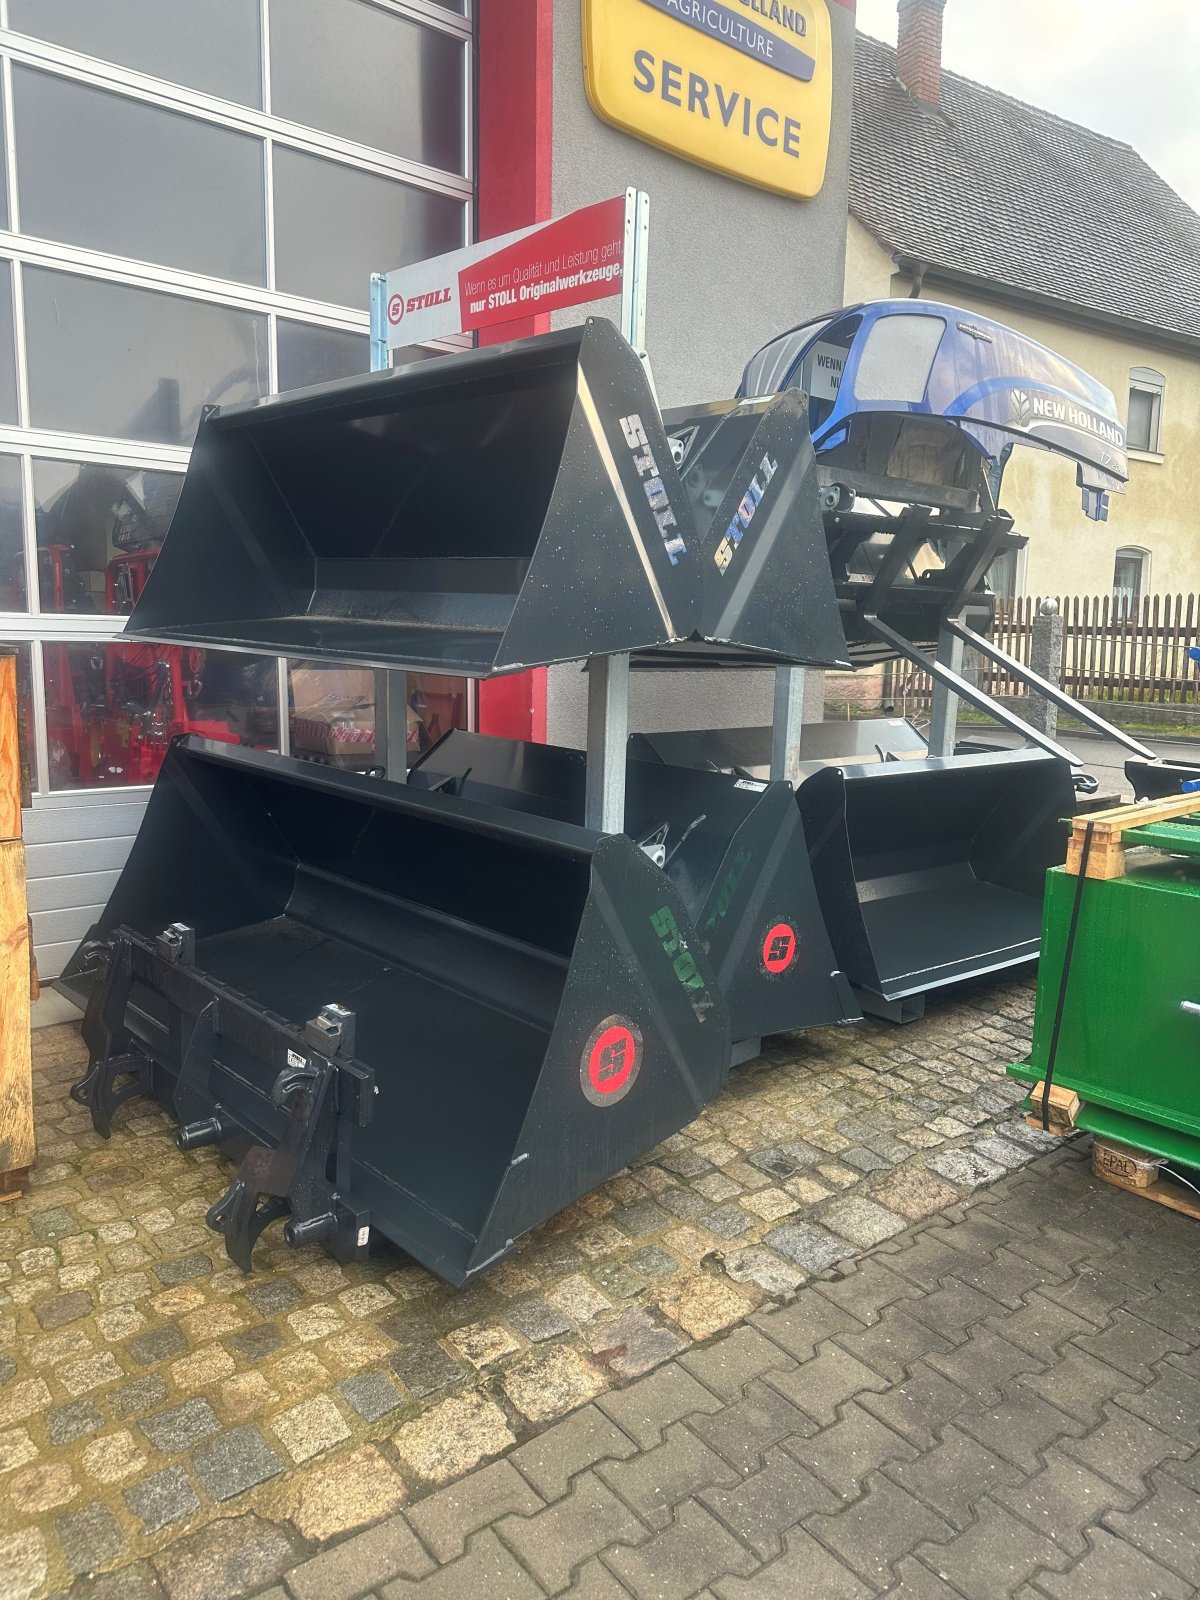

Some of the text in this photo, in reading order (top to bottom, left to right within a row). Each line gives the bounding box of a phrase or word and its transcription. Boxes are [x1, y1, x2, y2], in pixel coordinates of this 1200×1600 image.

[633, 49, 801, 159] SERVICE
[464, 281, 486, 297] Wenn
[487, 277, 497, 290] es
[498, 273, 511, 287] um
[512, 262, 543, 283] Qualität
[544, 257, 560, 274] und
[562, 247, 599, 270] Leistung
[405, 287, 452, 313] STOLL
[470, 299, 486, 314] nur
[488, 288, 517, 310] STOLL
[817, 353, 842, 372] WENN
[1033, 397, 1125, 447] NEW HOLLAND
[618, 413, 687, 566] STOLL
[714, 451, 779, 577] STOLL
